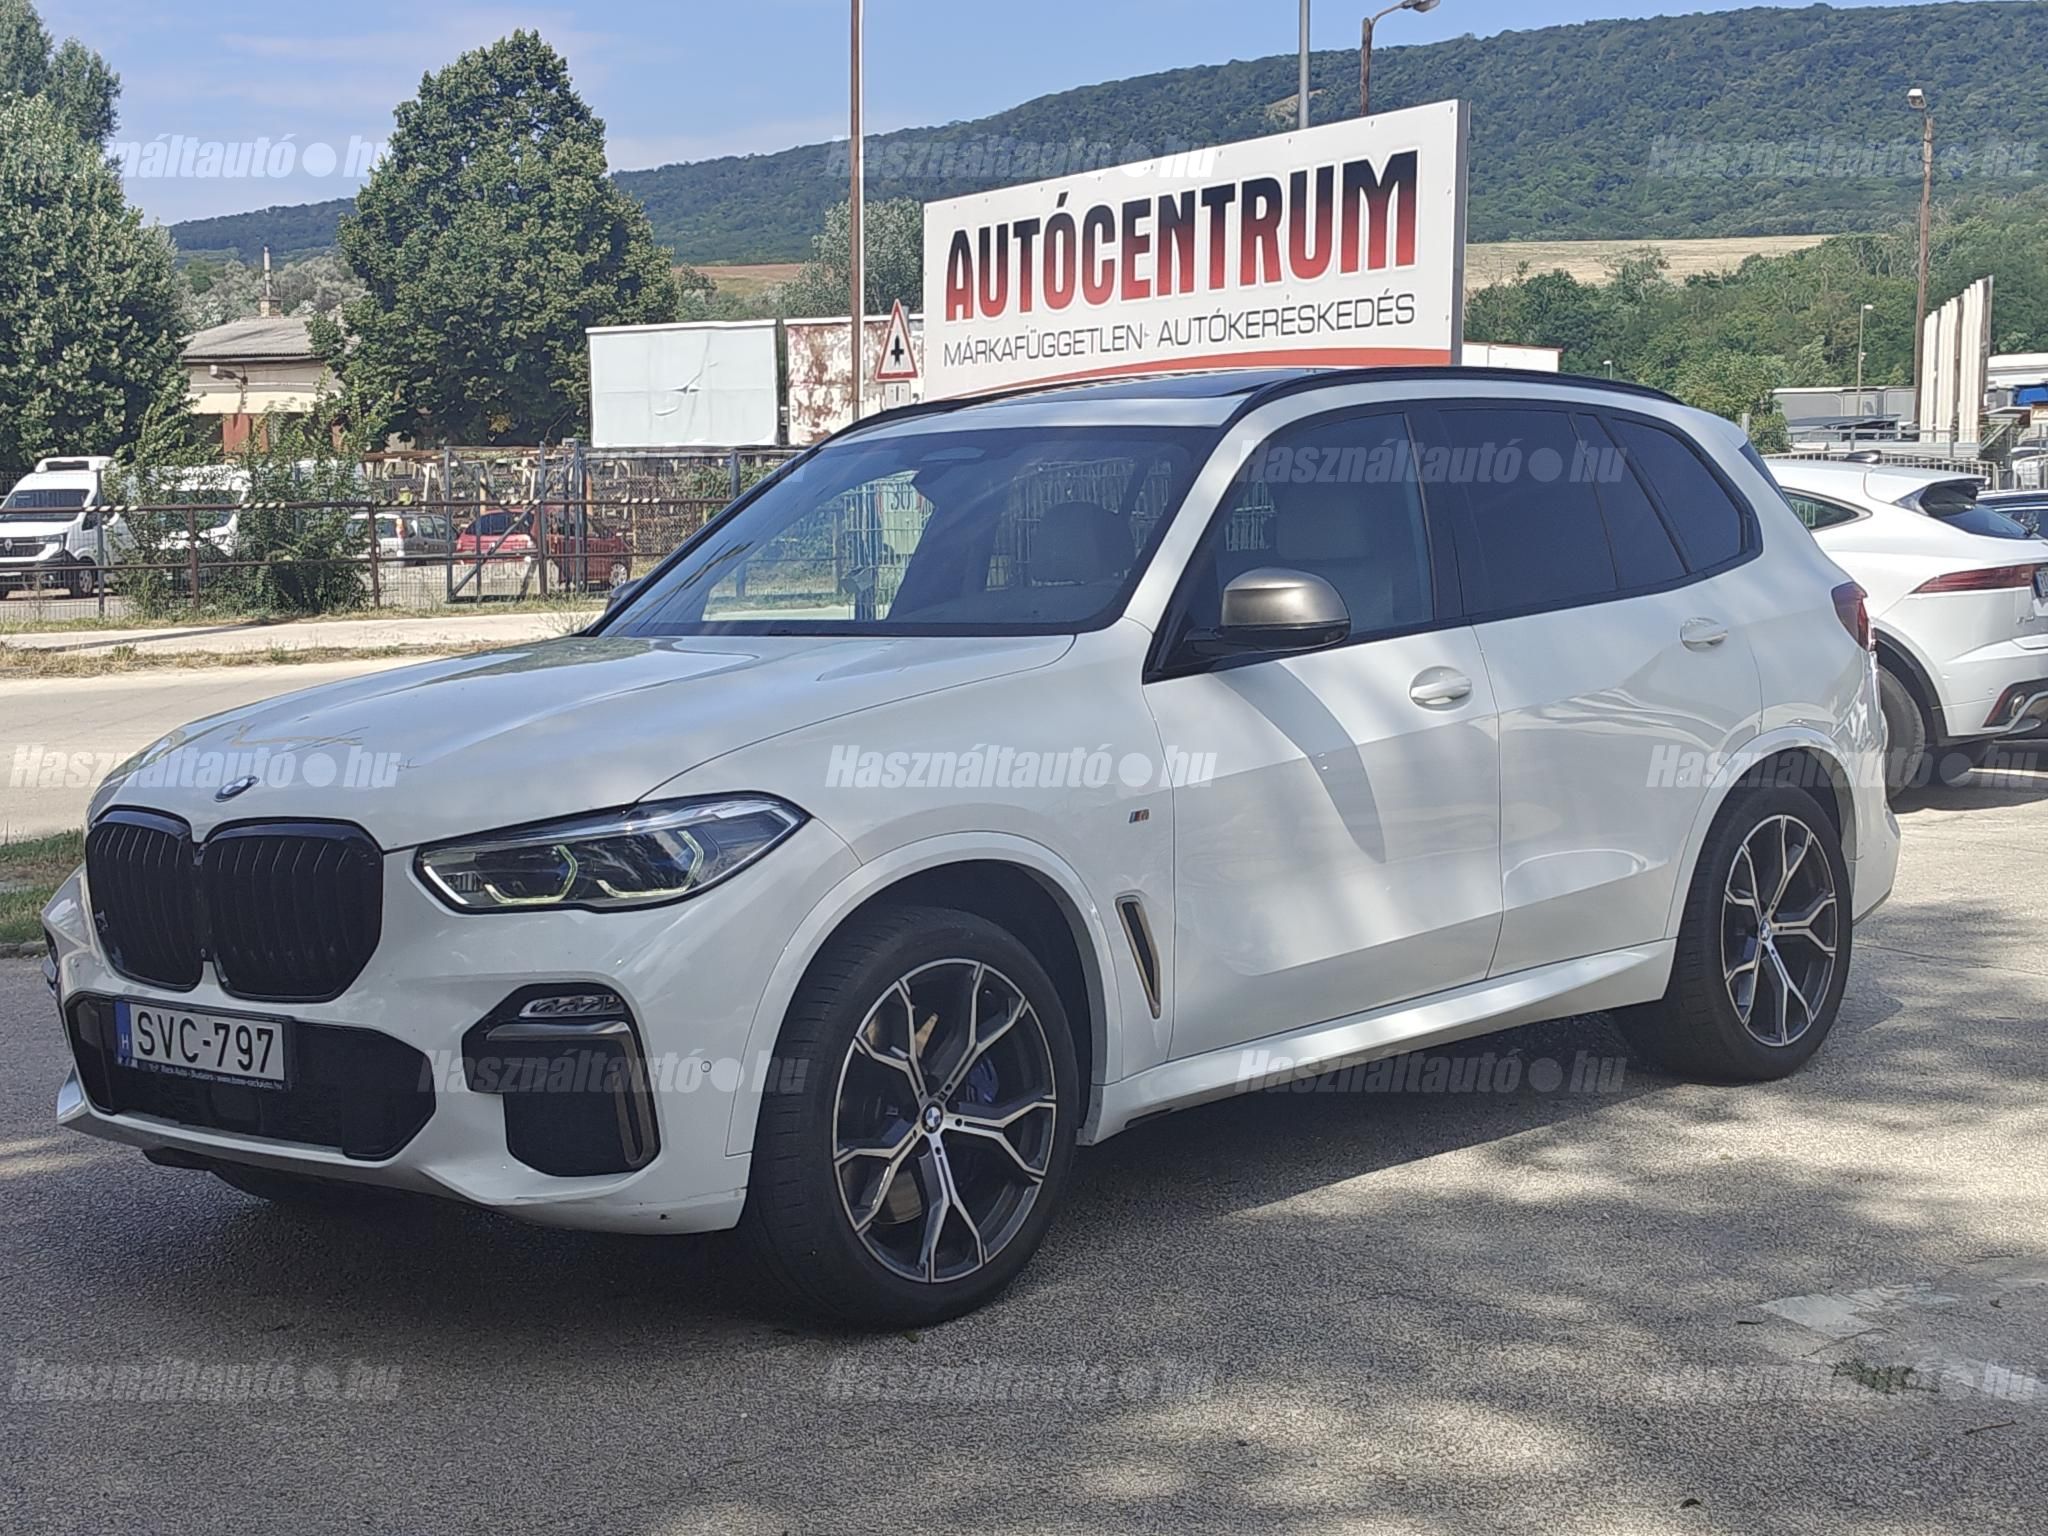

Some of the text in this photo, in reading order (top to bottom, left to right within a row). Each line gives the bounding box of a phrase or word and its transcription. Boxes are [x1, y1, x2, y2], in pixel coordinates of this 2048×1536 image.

[945, 150, 1419, 322] AUTÓCENTRUM
[943, 288, 1415, 367] MÁRKAFÜGGETLEN AUTÓKERESKEDÉS
[121, 1011, 274, 1073] H SVC-797
